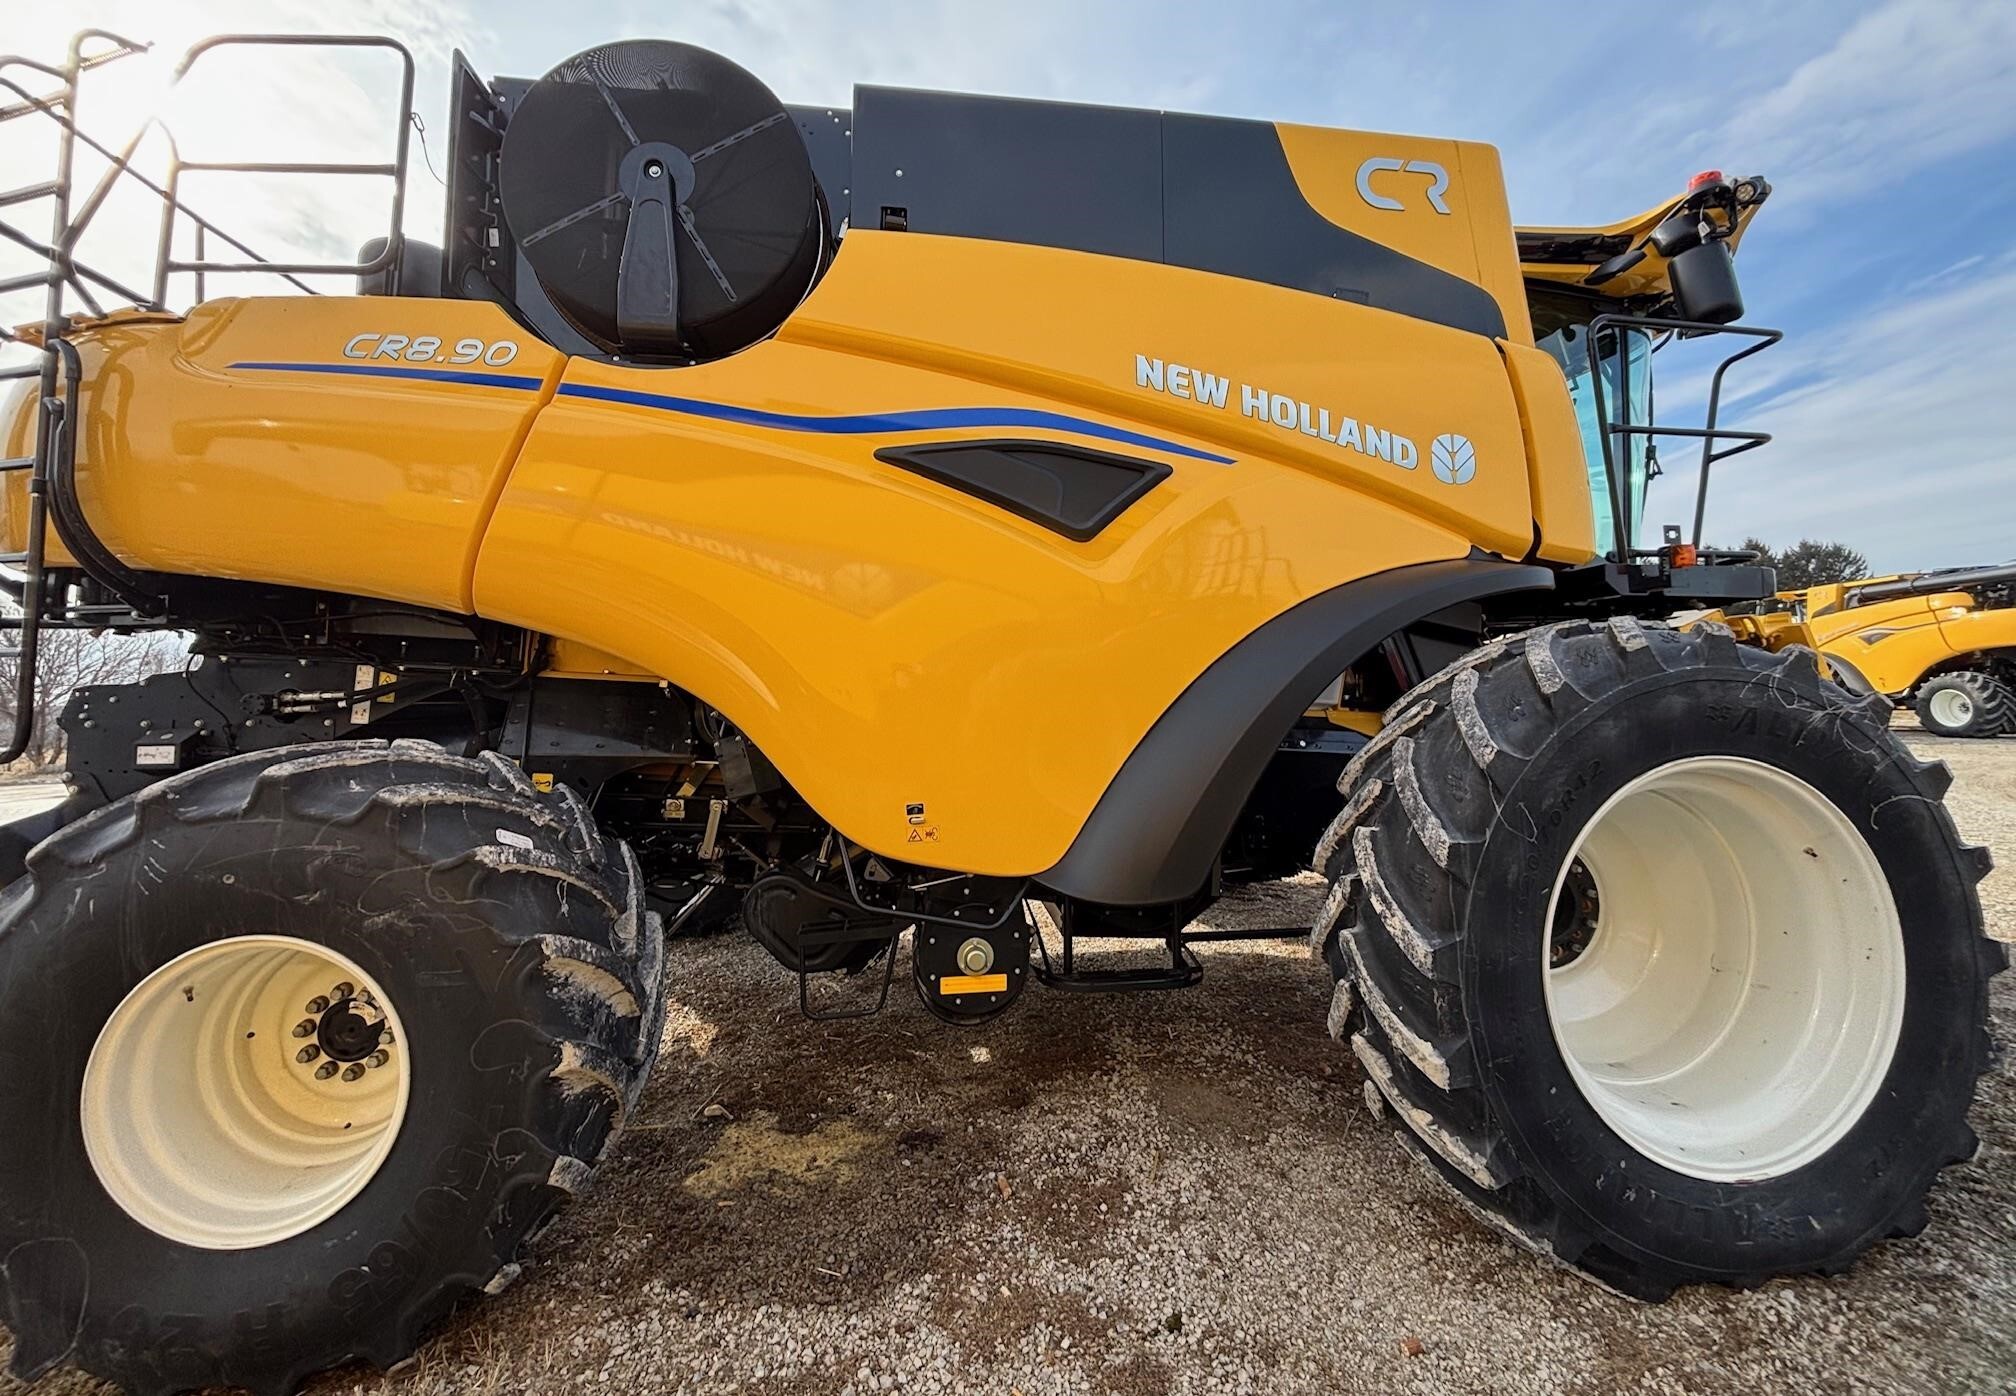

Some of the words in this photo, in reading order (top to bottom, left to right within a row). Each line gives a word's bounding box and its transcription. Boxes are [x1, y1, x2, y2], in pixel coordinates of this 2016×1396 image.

[1355, 157, 1451, 215] CR
[343, 333, 518, 367] CR8.90
[1135, 353, 1231, 409] NEW
[1240, 383, 1419, 470] HOLLAND
